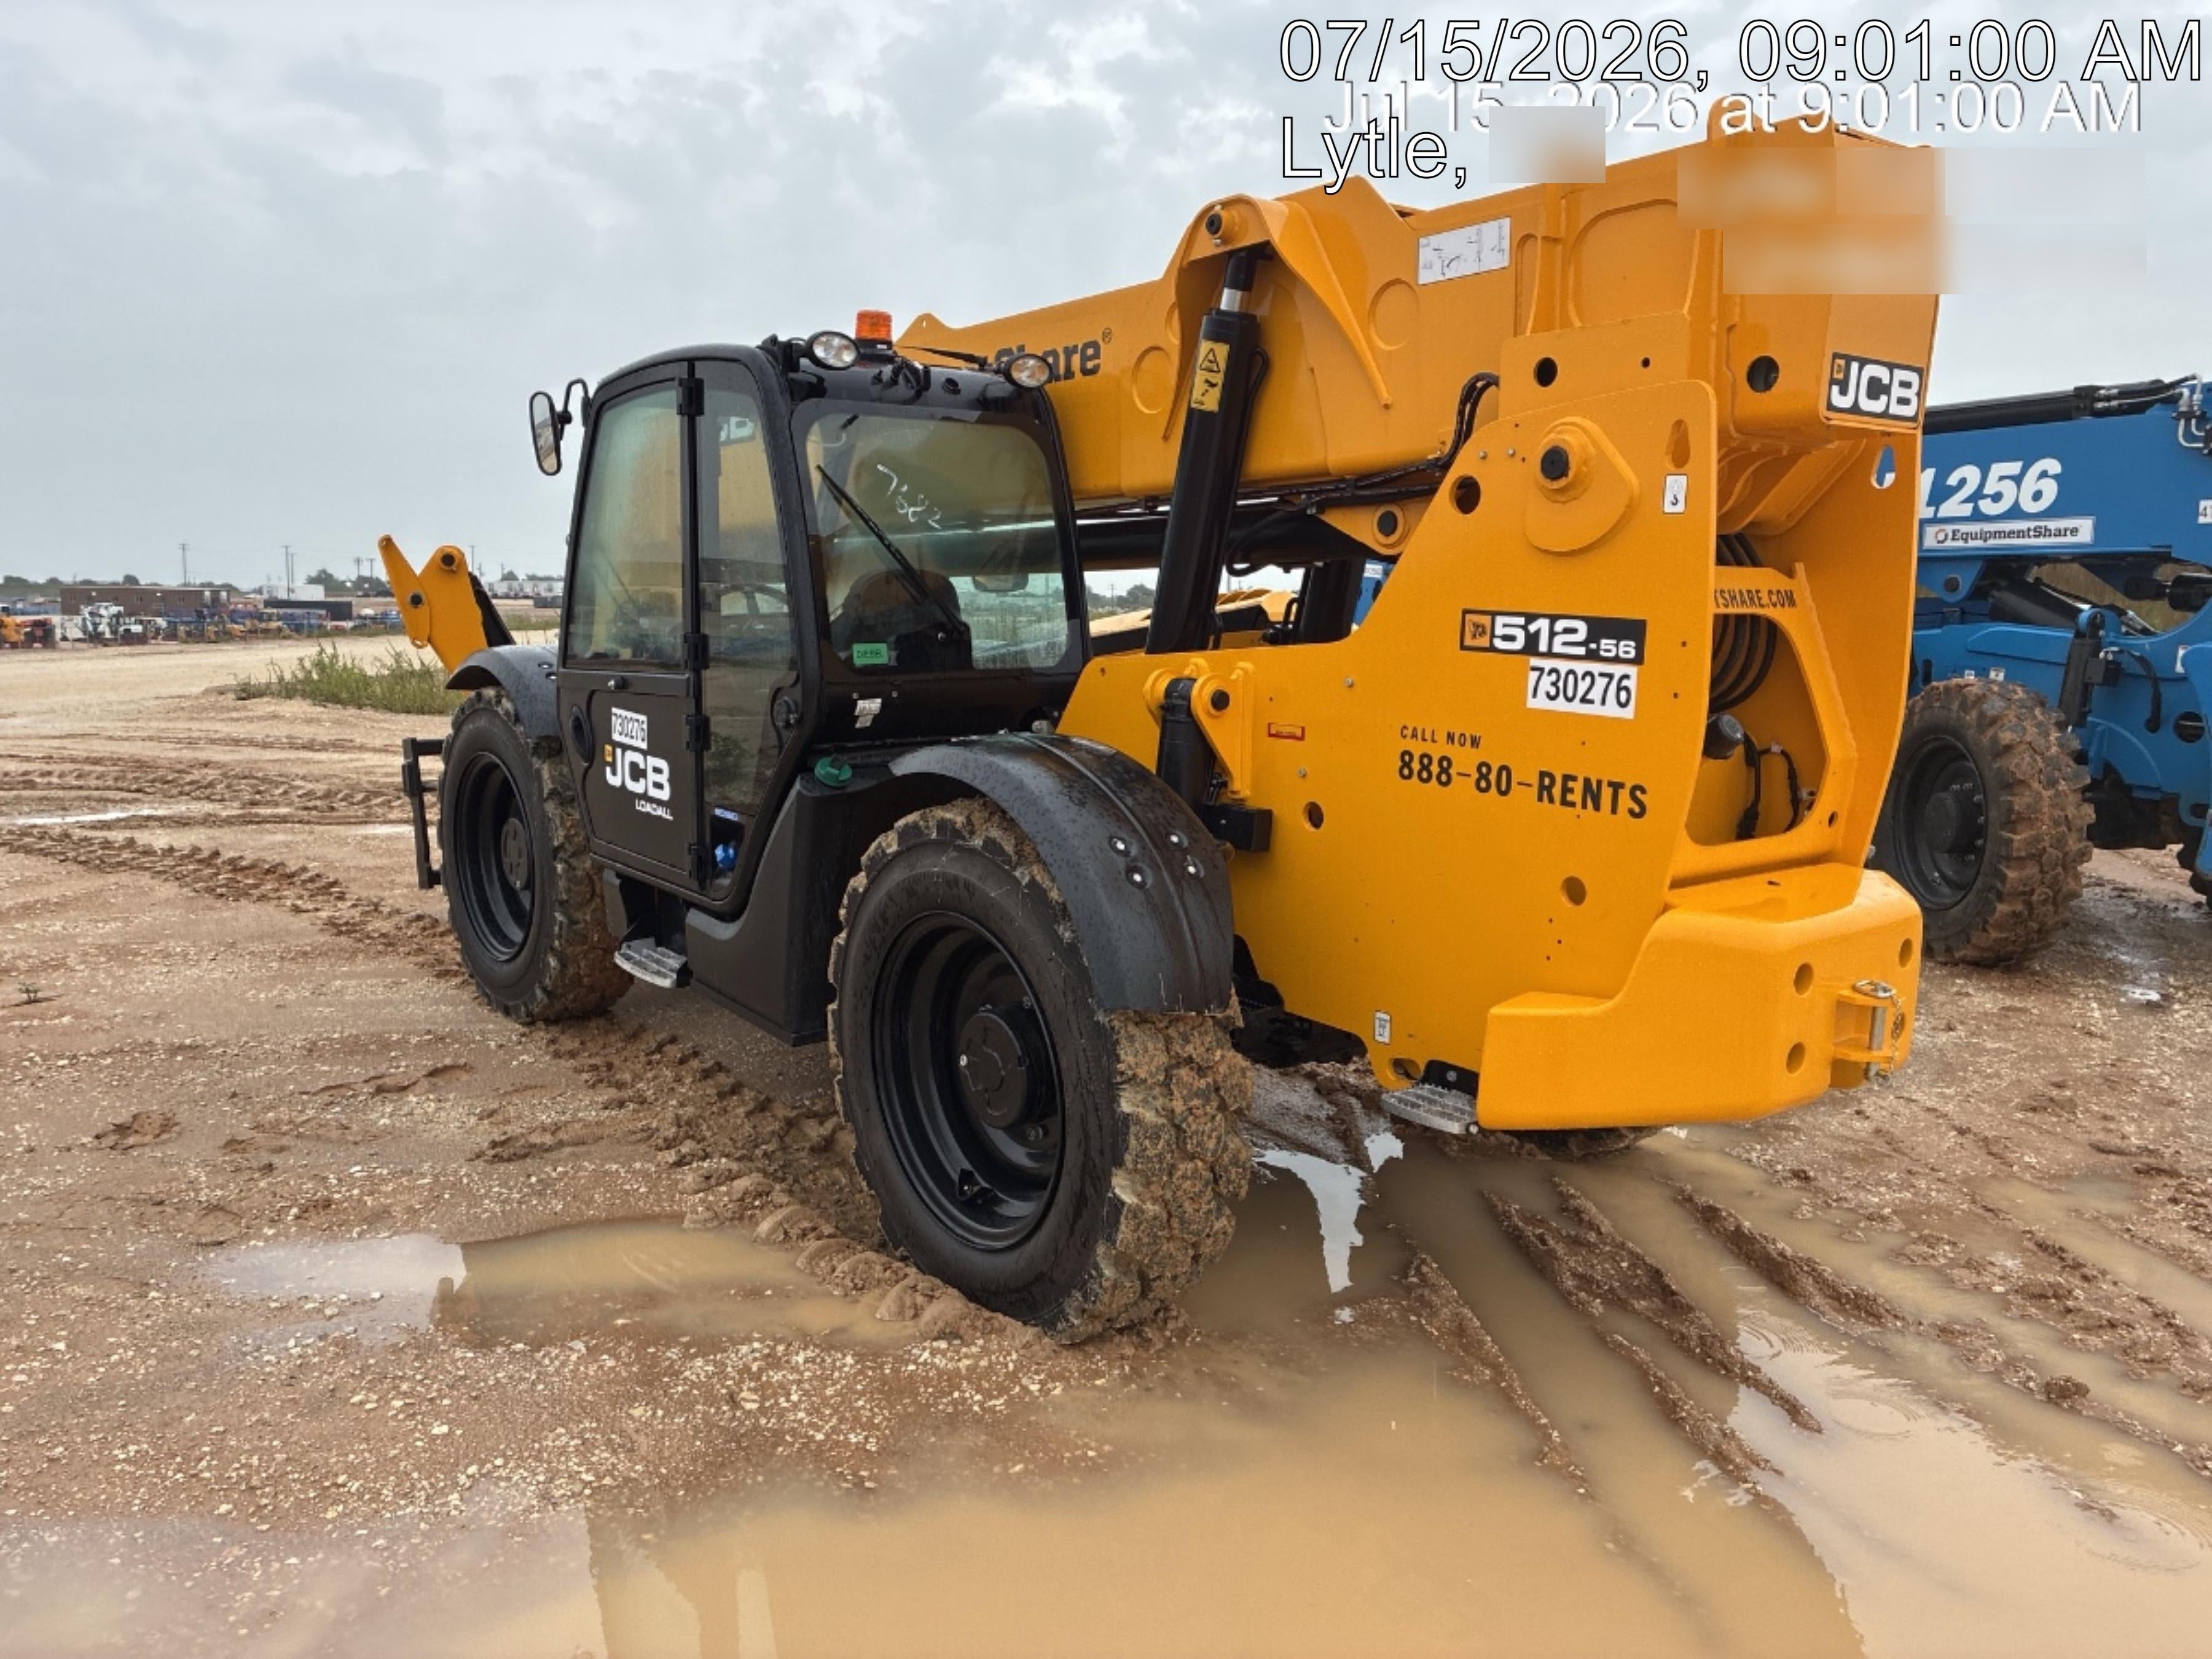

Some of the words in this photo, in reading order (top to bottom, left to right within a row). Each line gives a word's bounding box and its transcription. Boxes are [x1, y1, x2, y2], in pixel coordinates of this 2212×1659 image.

[1830, 360, 1920, 418] JCB
[1950, 525, 2082, 543] EquipmentShare
[1529, 665, 1632, 708] 730276
[613, 713, 646, 742] 730276
[1400, 725, 1438, 743] CALL
[1446, 731, 1483, 749] NOW
[606, 748, 671, 801] JCB
[1398, 749, 1648, 819] 888-80-RENTS
[635, 798, 674, 821] LOADALL
